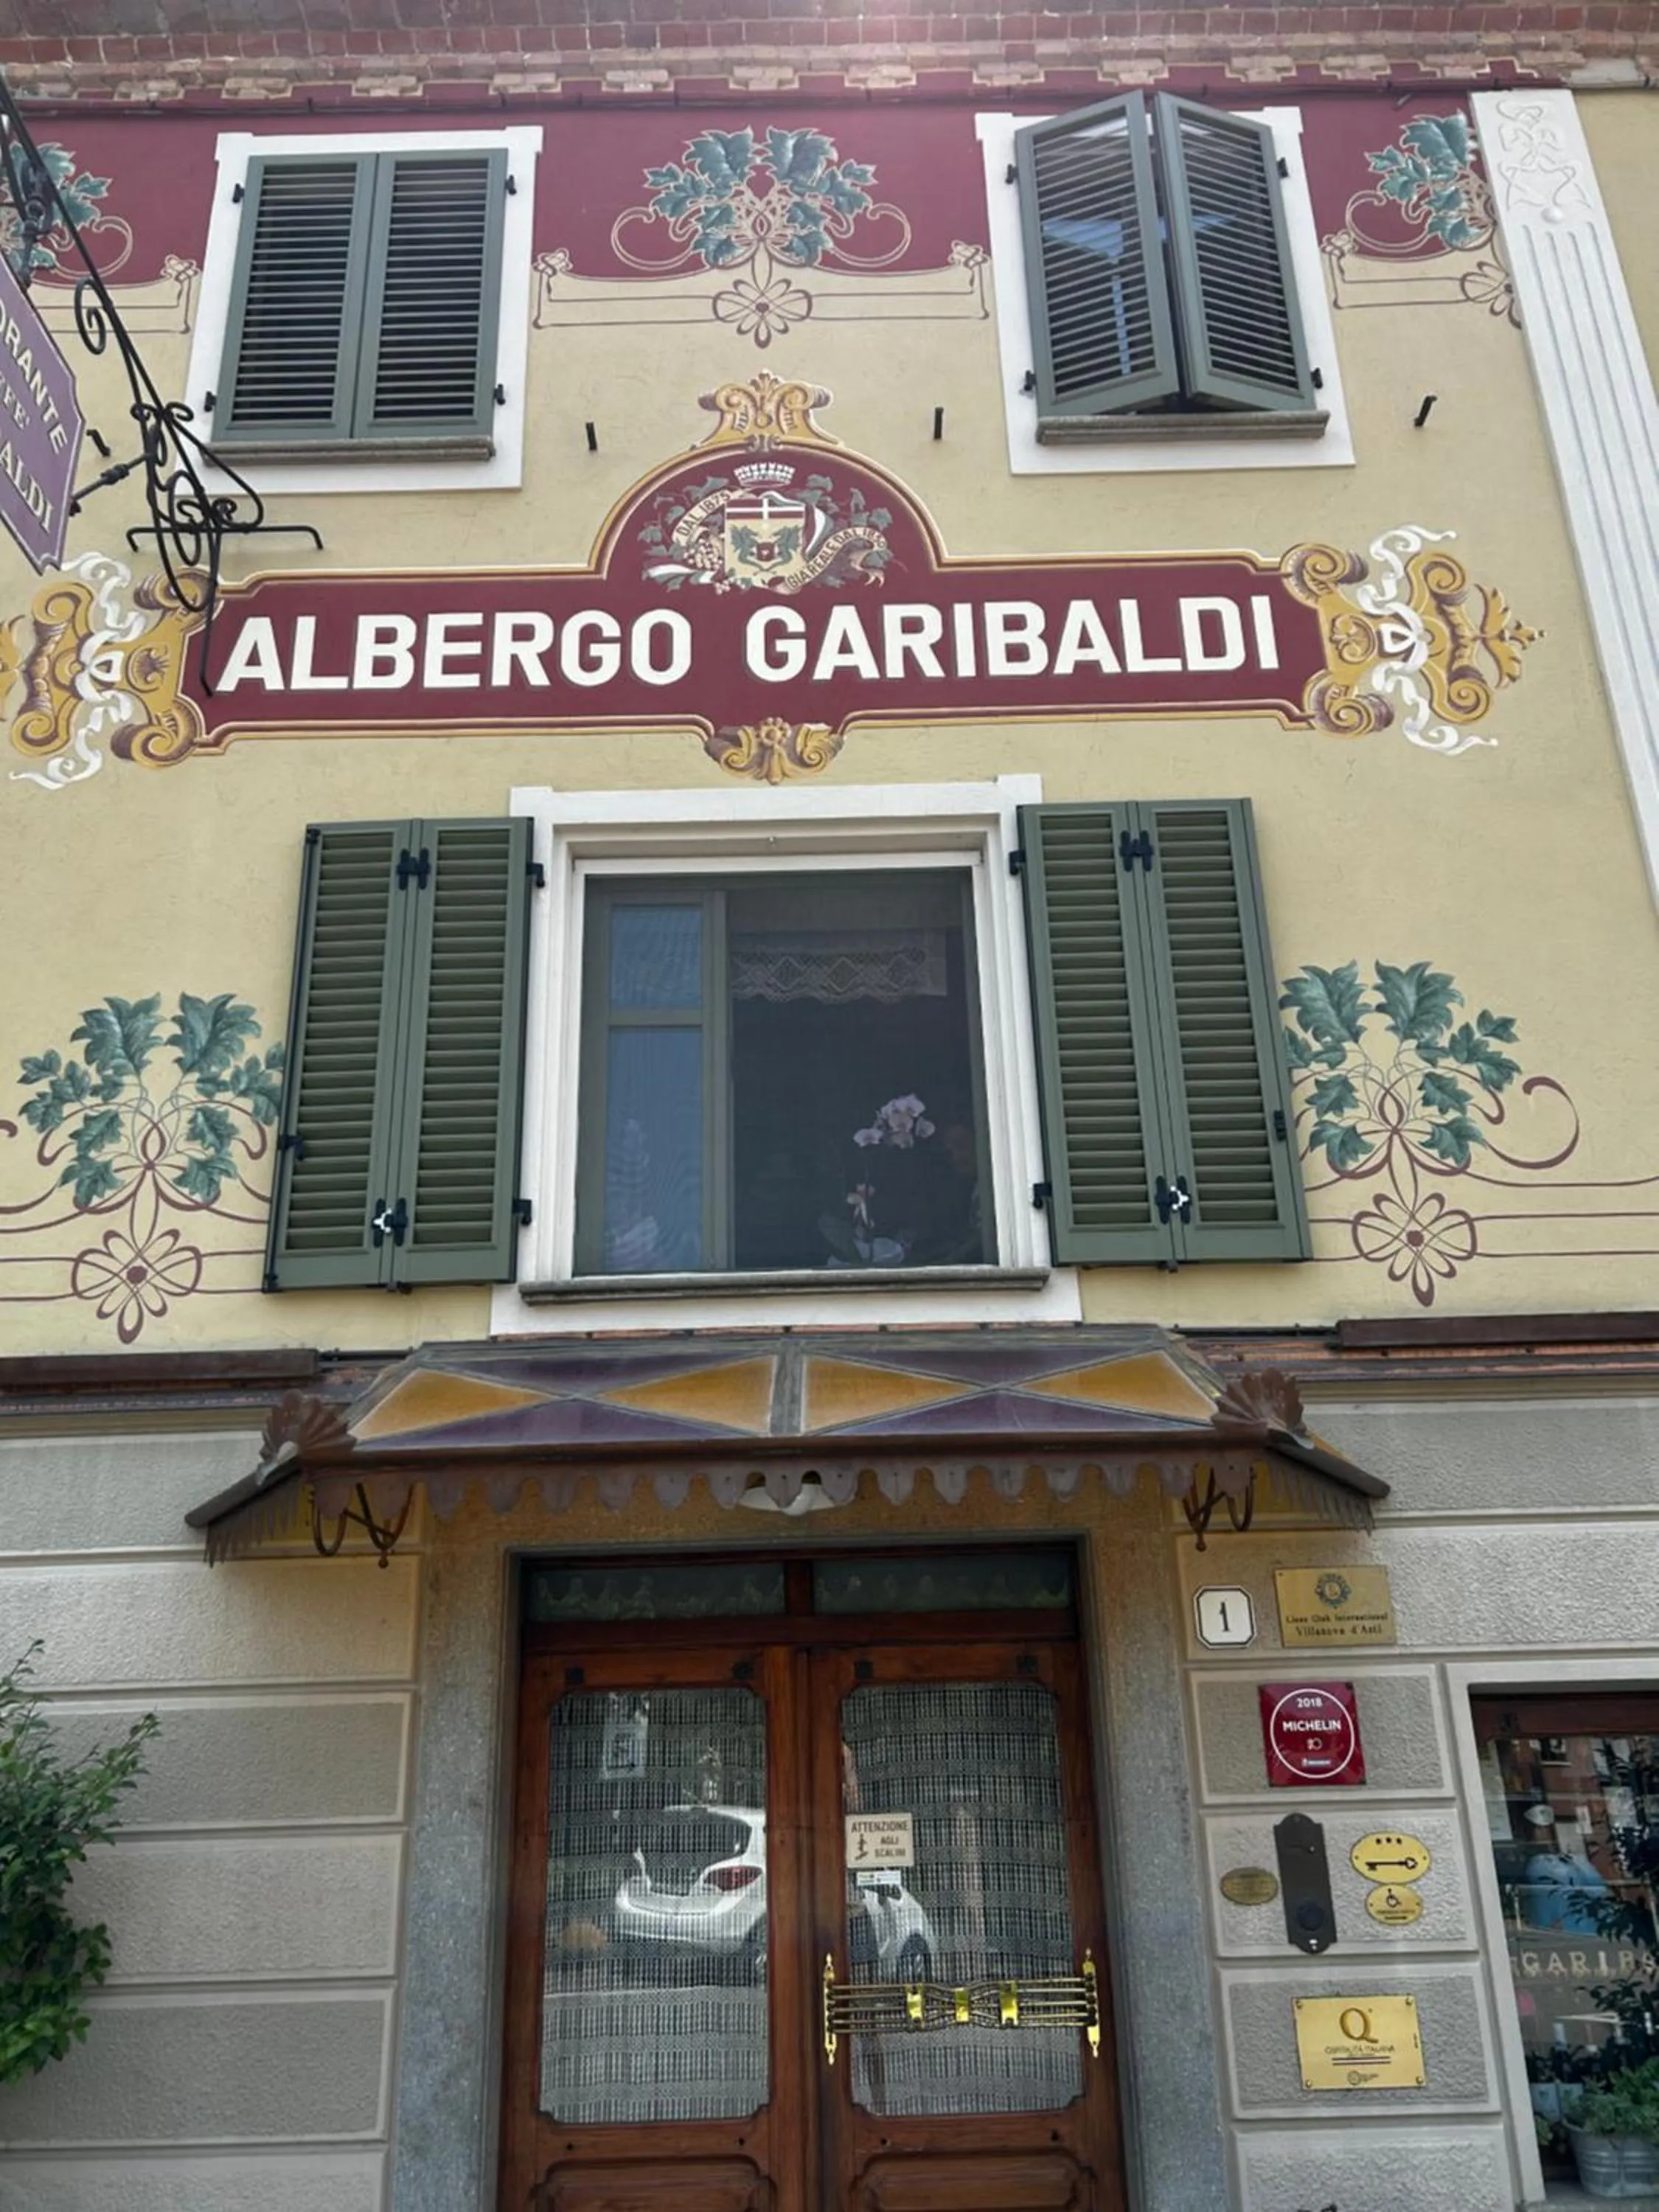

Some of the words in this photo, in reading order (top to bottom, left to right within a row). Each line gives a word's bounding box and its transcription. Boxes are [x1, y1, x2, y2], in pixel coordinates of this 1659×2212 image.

[215, 609, 692, 692] ALBERGO
[745, 595, 1279, 683] GARIBALDI
[1219, 1601, 1231, 1632] 1
[1296, 1697, 1323, 1708] 2018
[1282, 1719, 1341, 1732] MICHELIN
[851, 1820, 908, 1834] ATTENZIONE
[1339, 2007, 1379, 2044] Q
